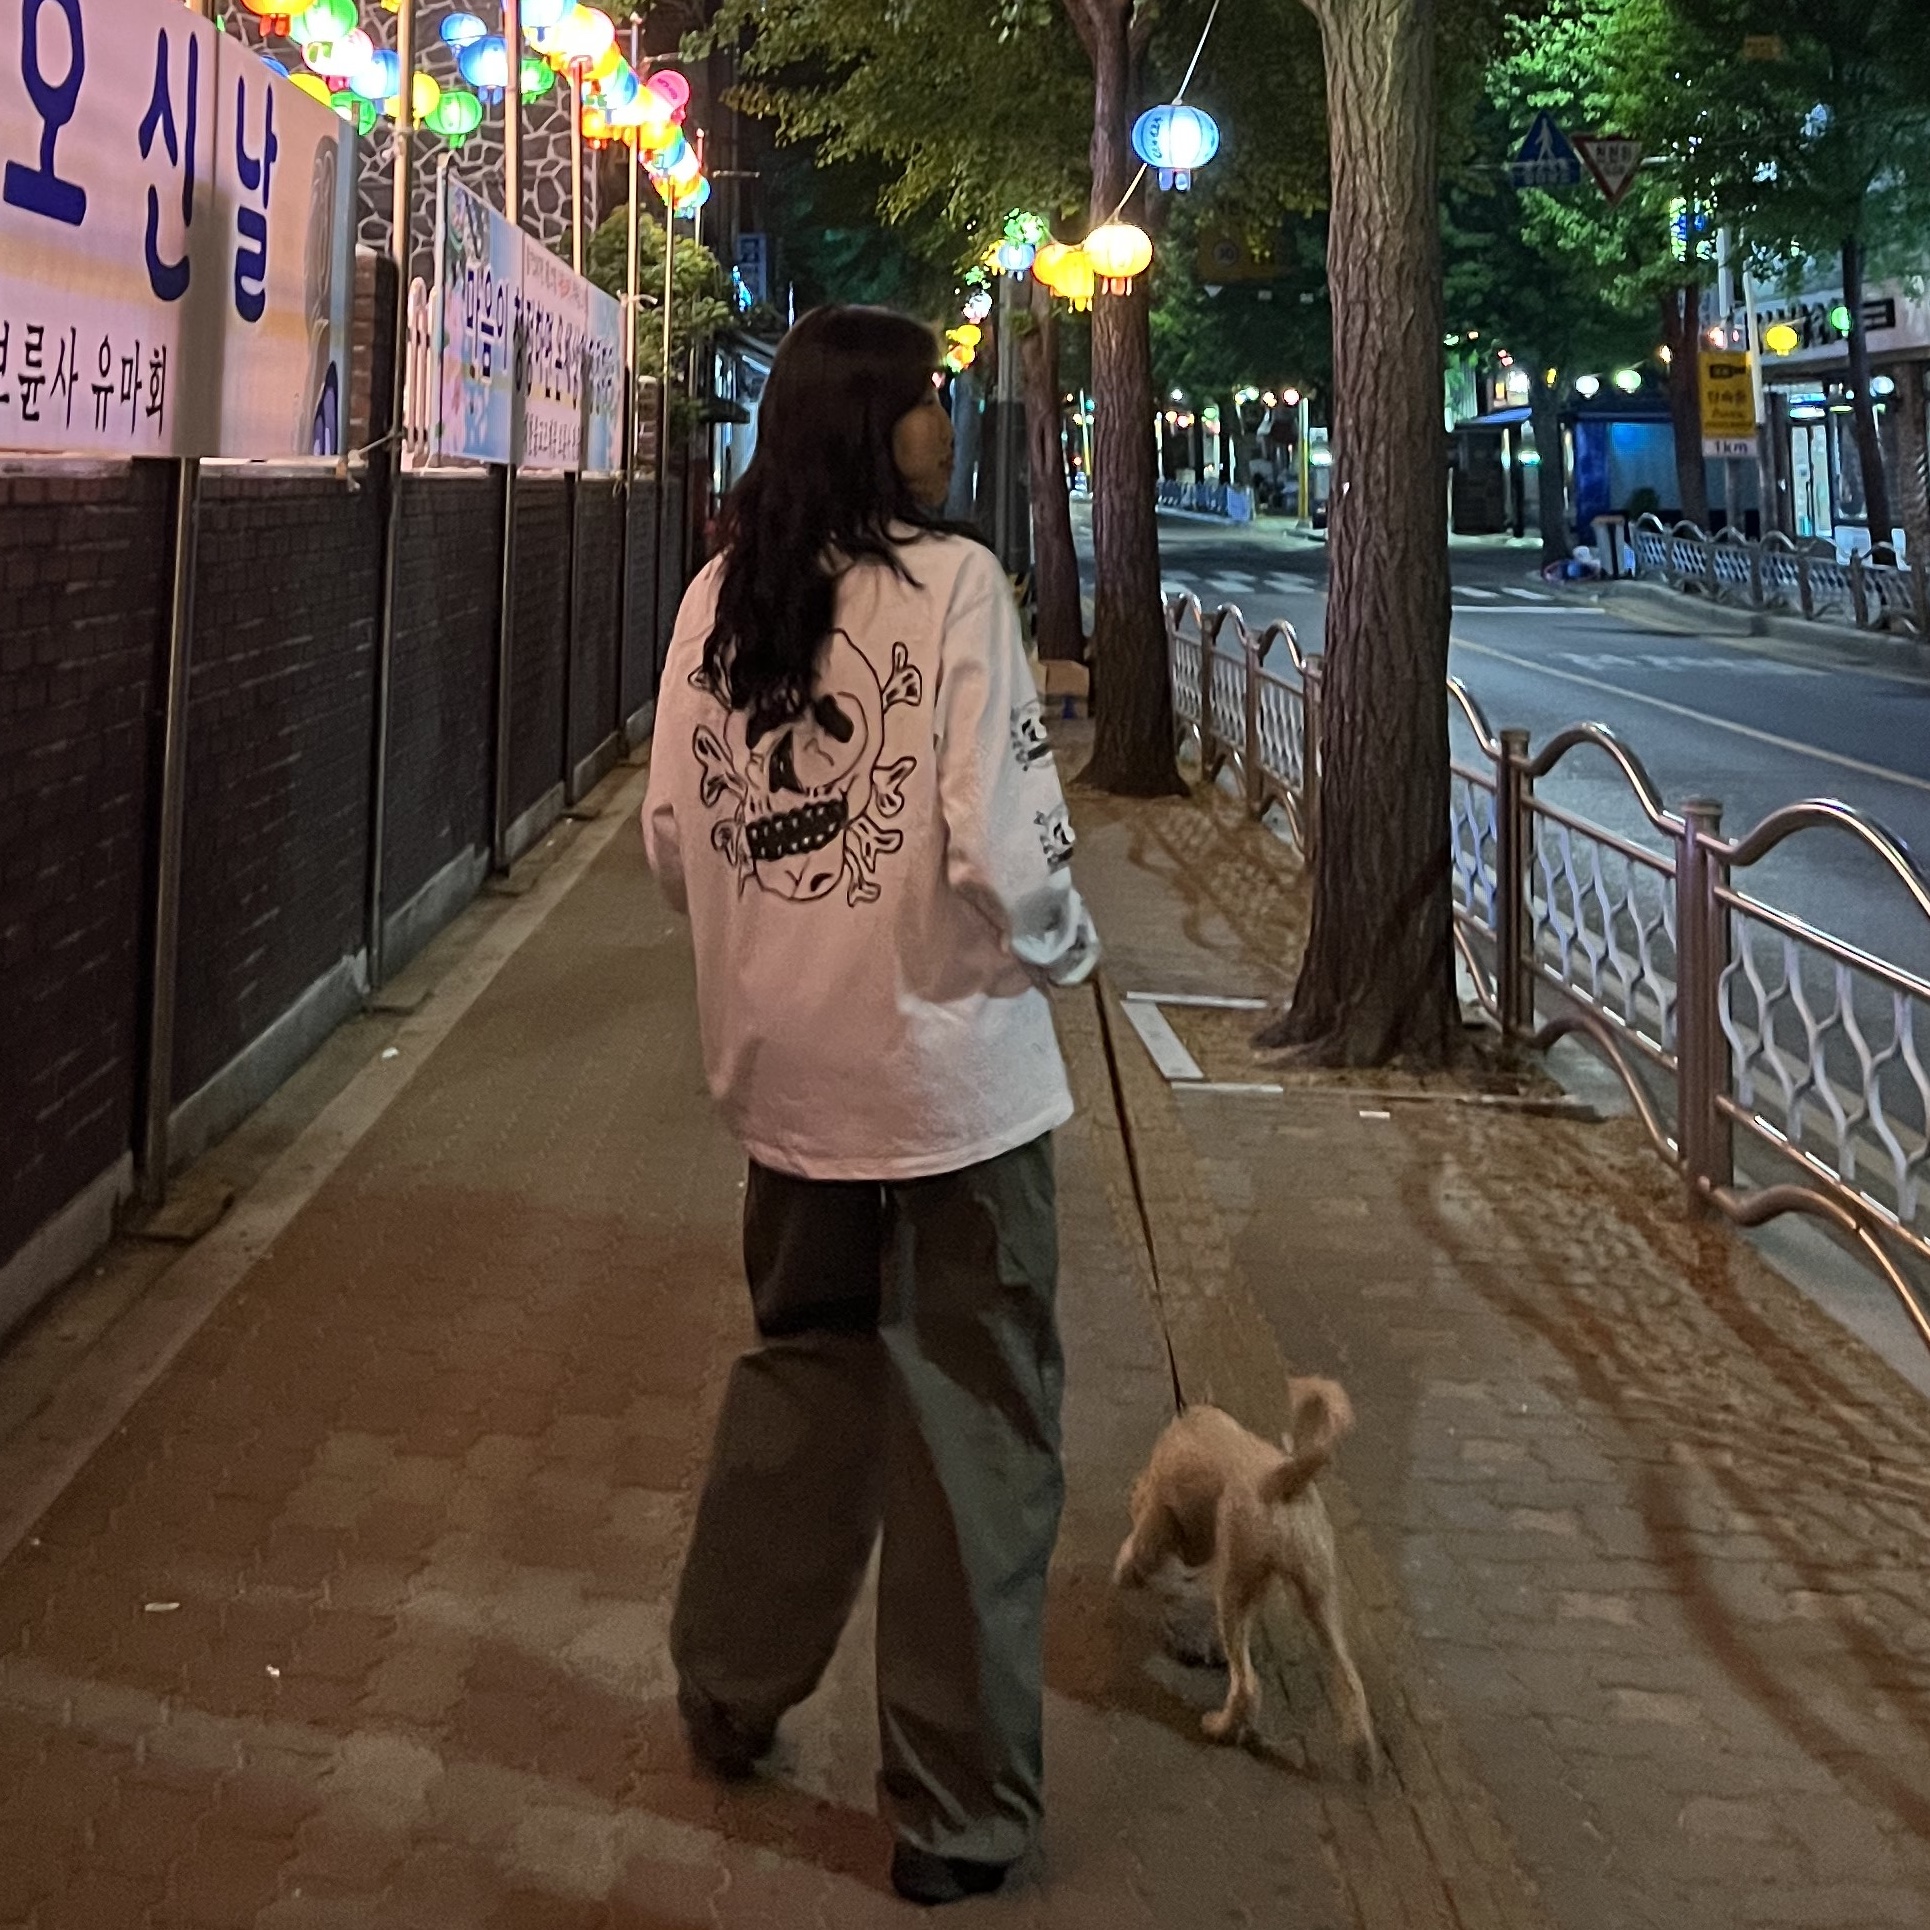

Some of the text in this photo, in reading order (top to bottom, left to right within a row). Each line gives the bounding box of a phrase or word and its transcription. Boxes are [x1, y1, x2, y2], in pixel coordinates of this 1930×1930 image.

[3, 0, 279, 323] 오신날
[91, 334, 167, 437] 유마회
[1715, 440, 1748, 454] 1km
